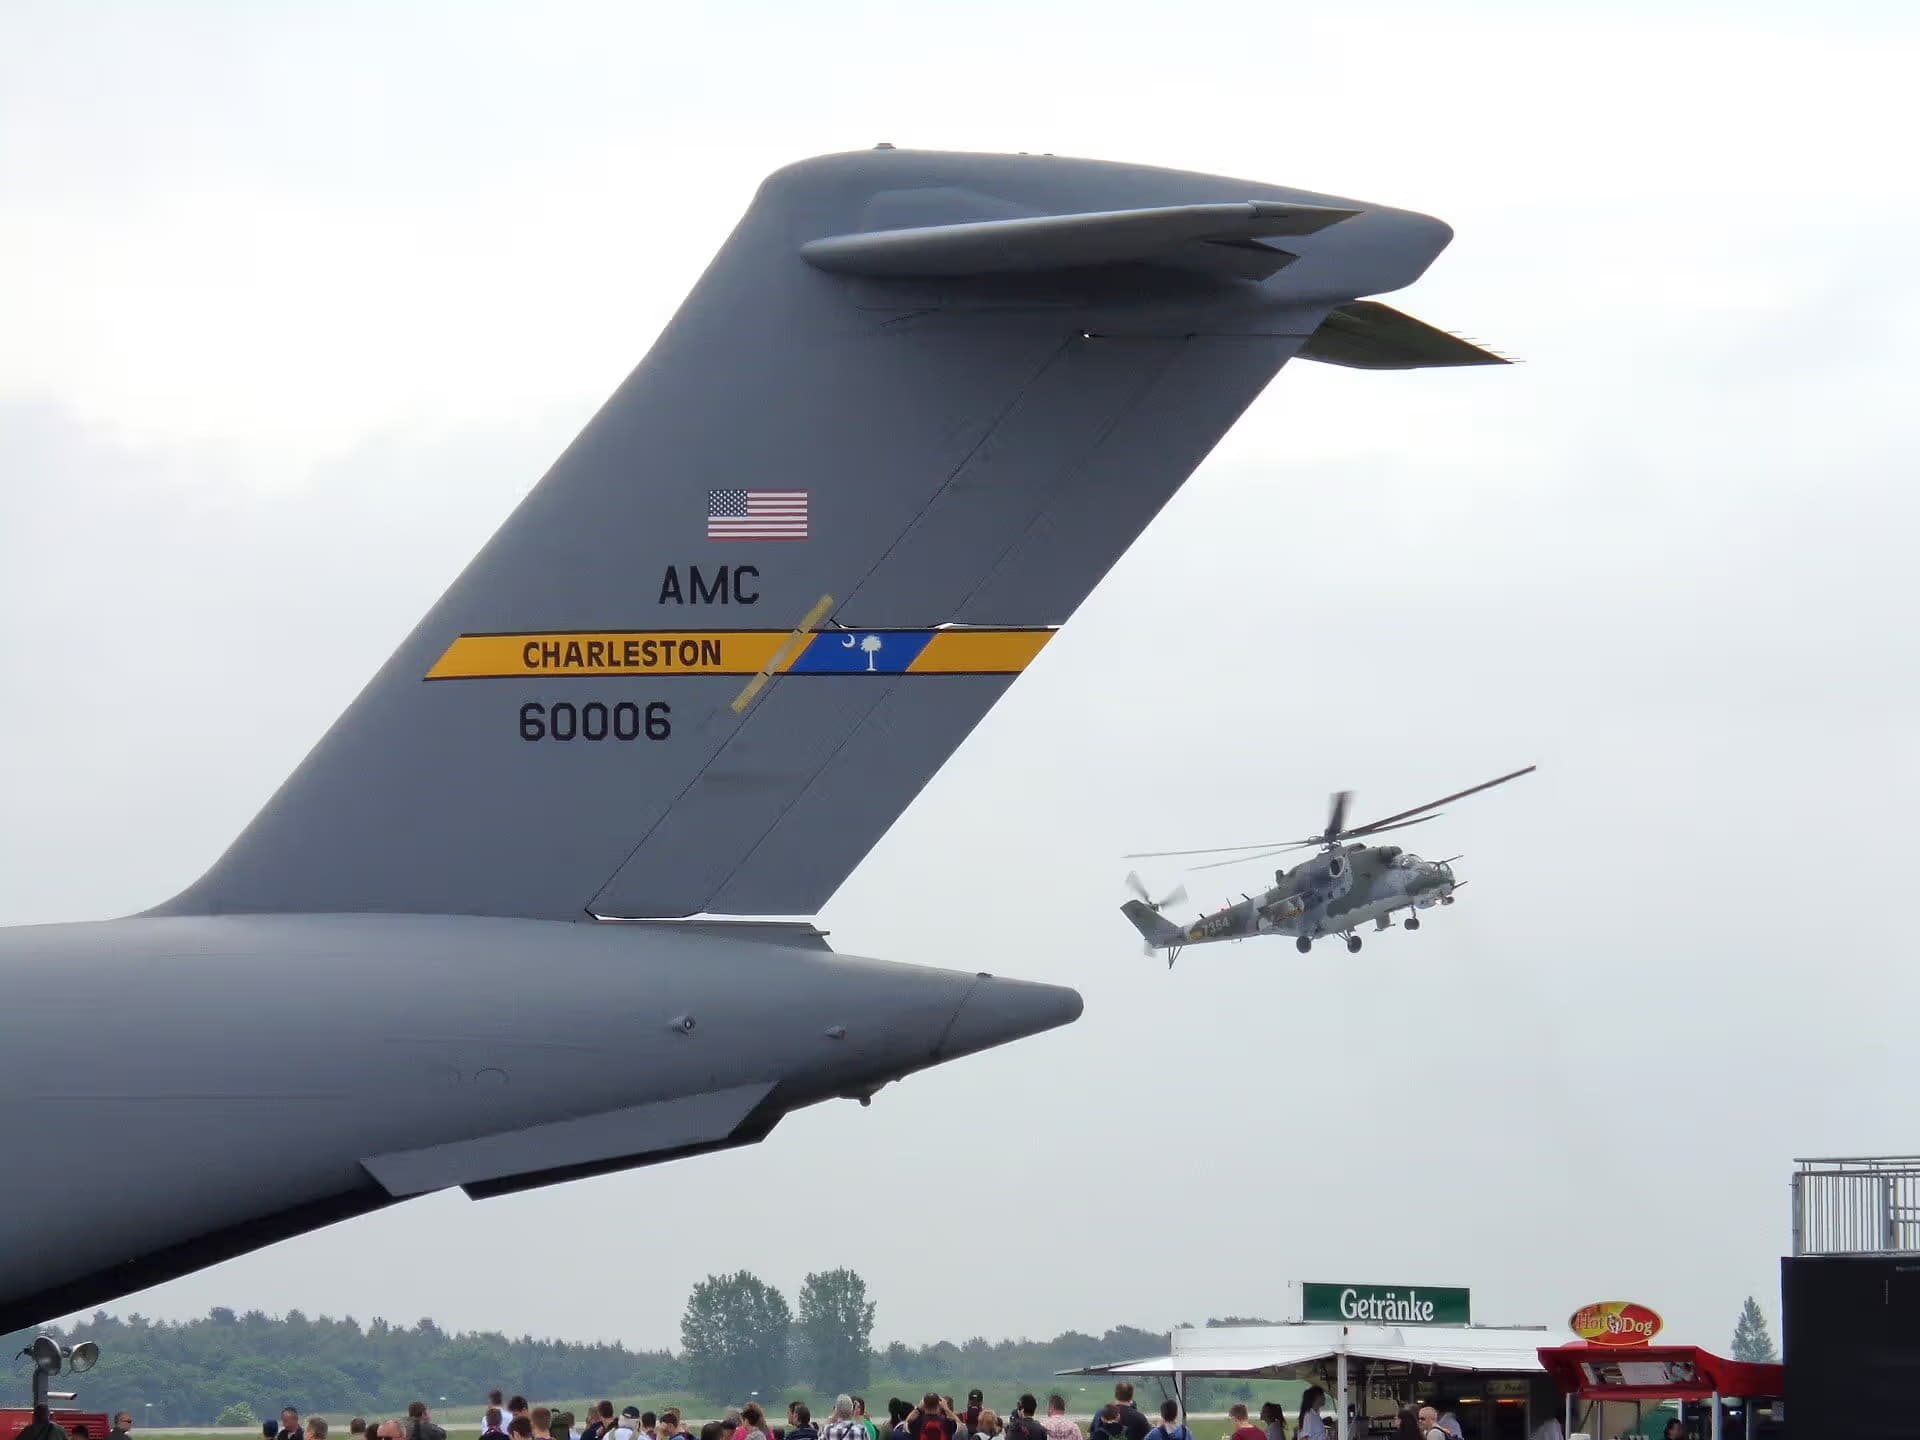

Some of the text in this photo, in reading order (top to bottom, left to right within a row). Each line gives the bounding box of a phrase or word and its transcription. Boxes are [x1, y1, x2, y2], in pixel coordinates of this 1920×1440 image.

[658, 565, 760, 605] AMC
[522, 639, 722, 669] CHARLESTON
[519, 702, 672, 742] 60006
[1340, 1288, 1434, 1322] Getränke
[1575, 1311, 1653, 1337] Hot Dog
